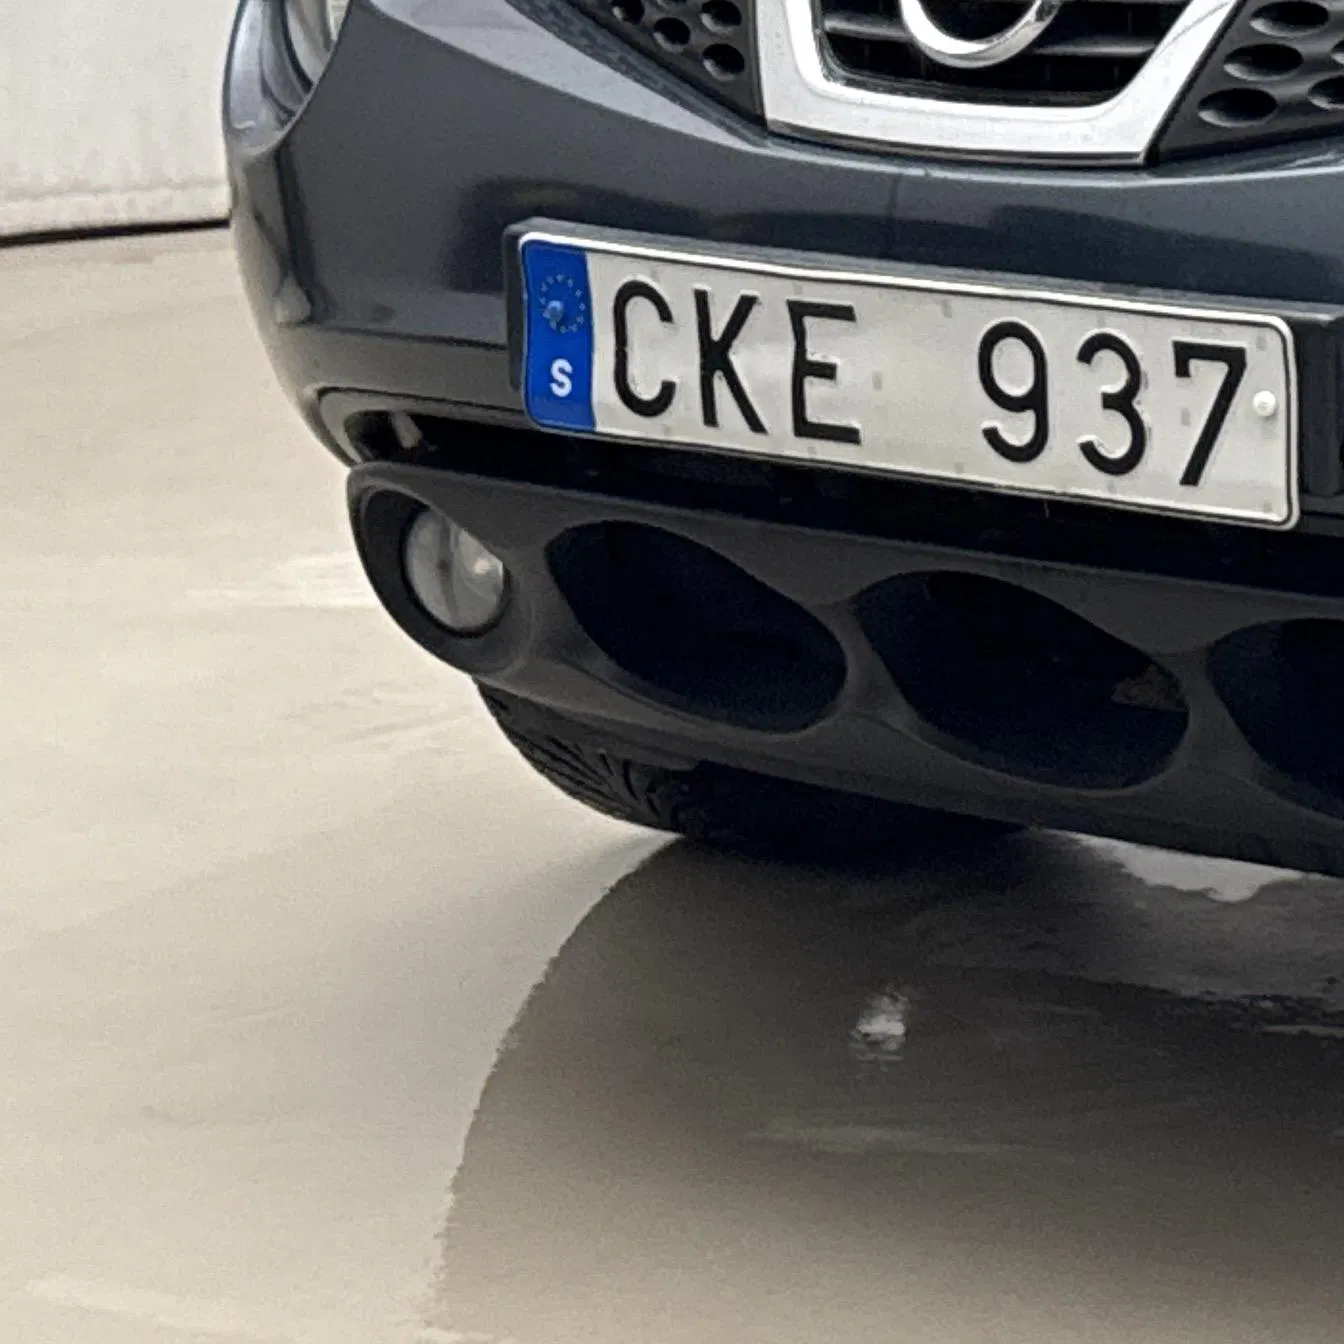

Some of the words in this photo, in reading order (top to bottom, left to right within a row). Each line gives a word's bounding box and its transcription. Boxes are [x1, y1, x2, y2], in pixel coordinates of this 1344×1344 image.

[549, 359, 573, 398] S
[613, 280, 862, 446] CKE
[978, 320, 1248, 487] 937
